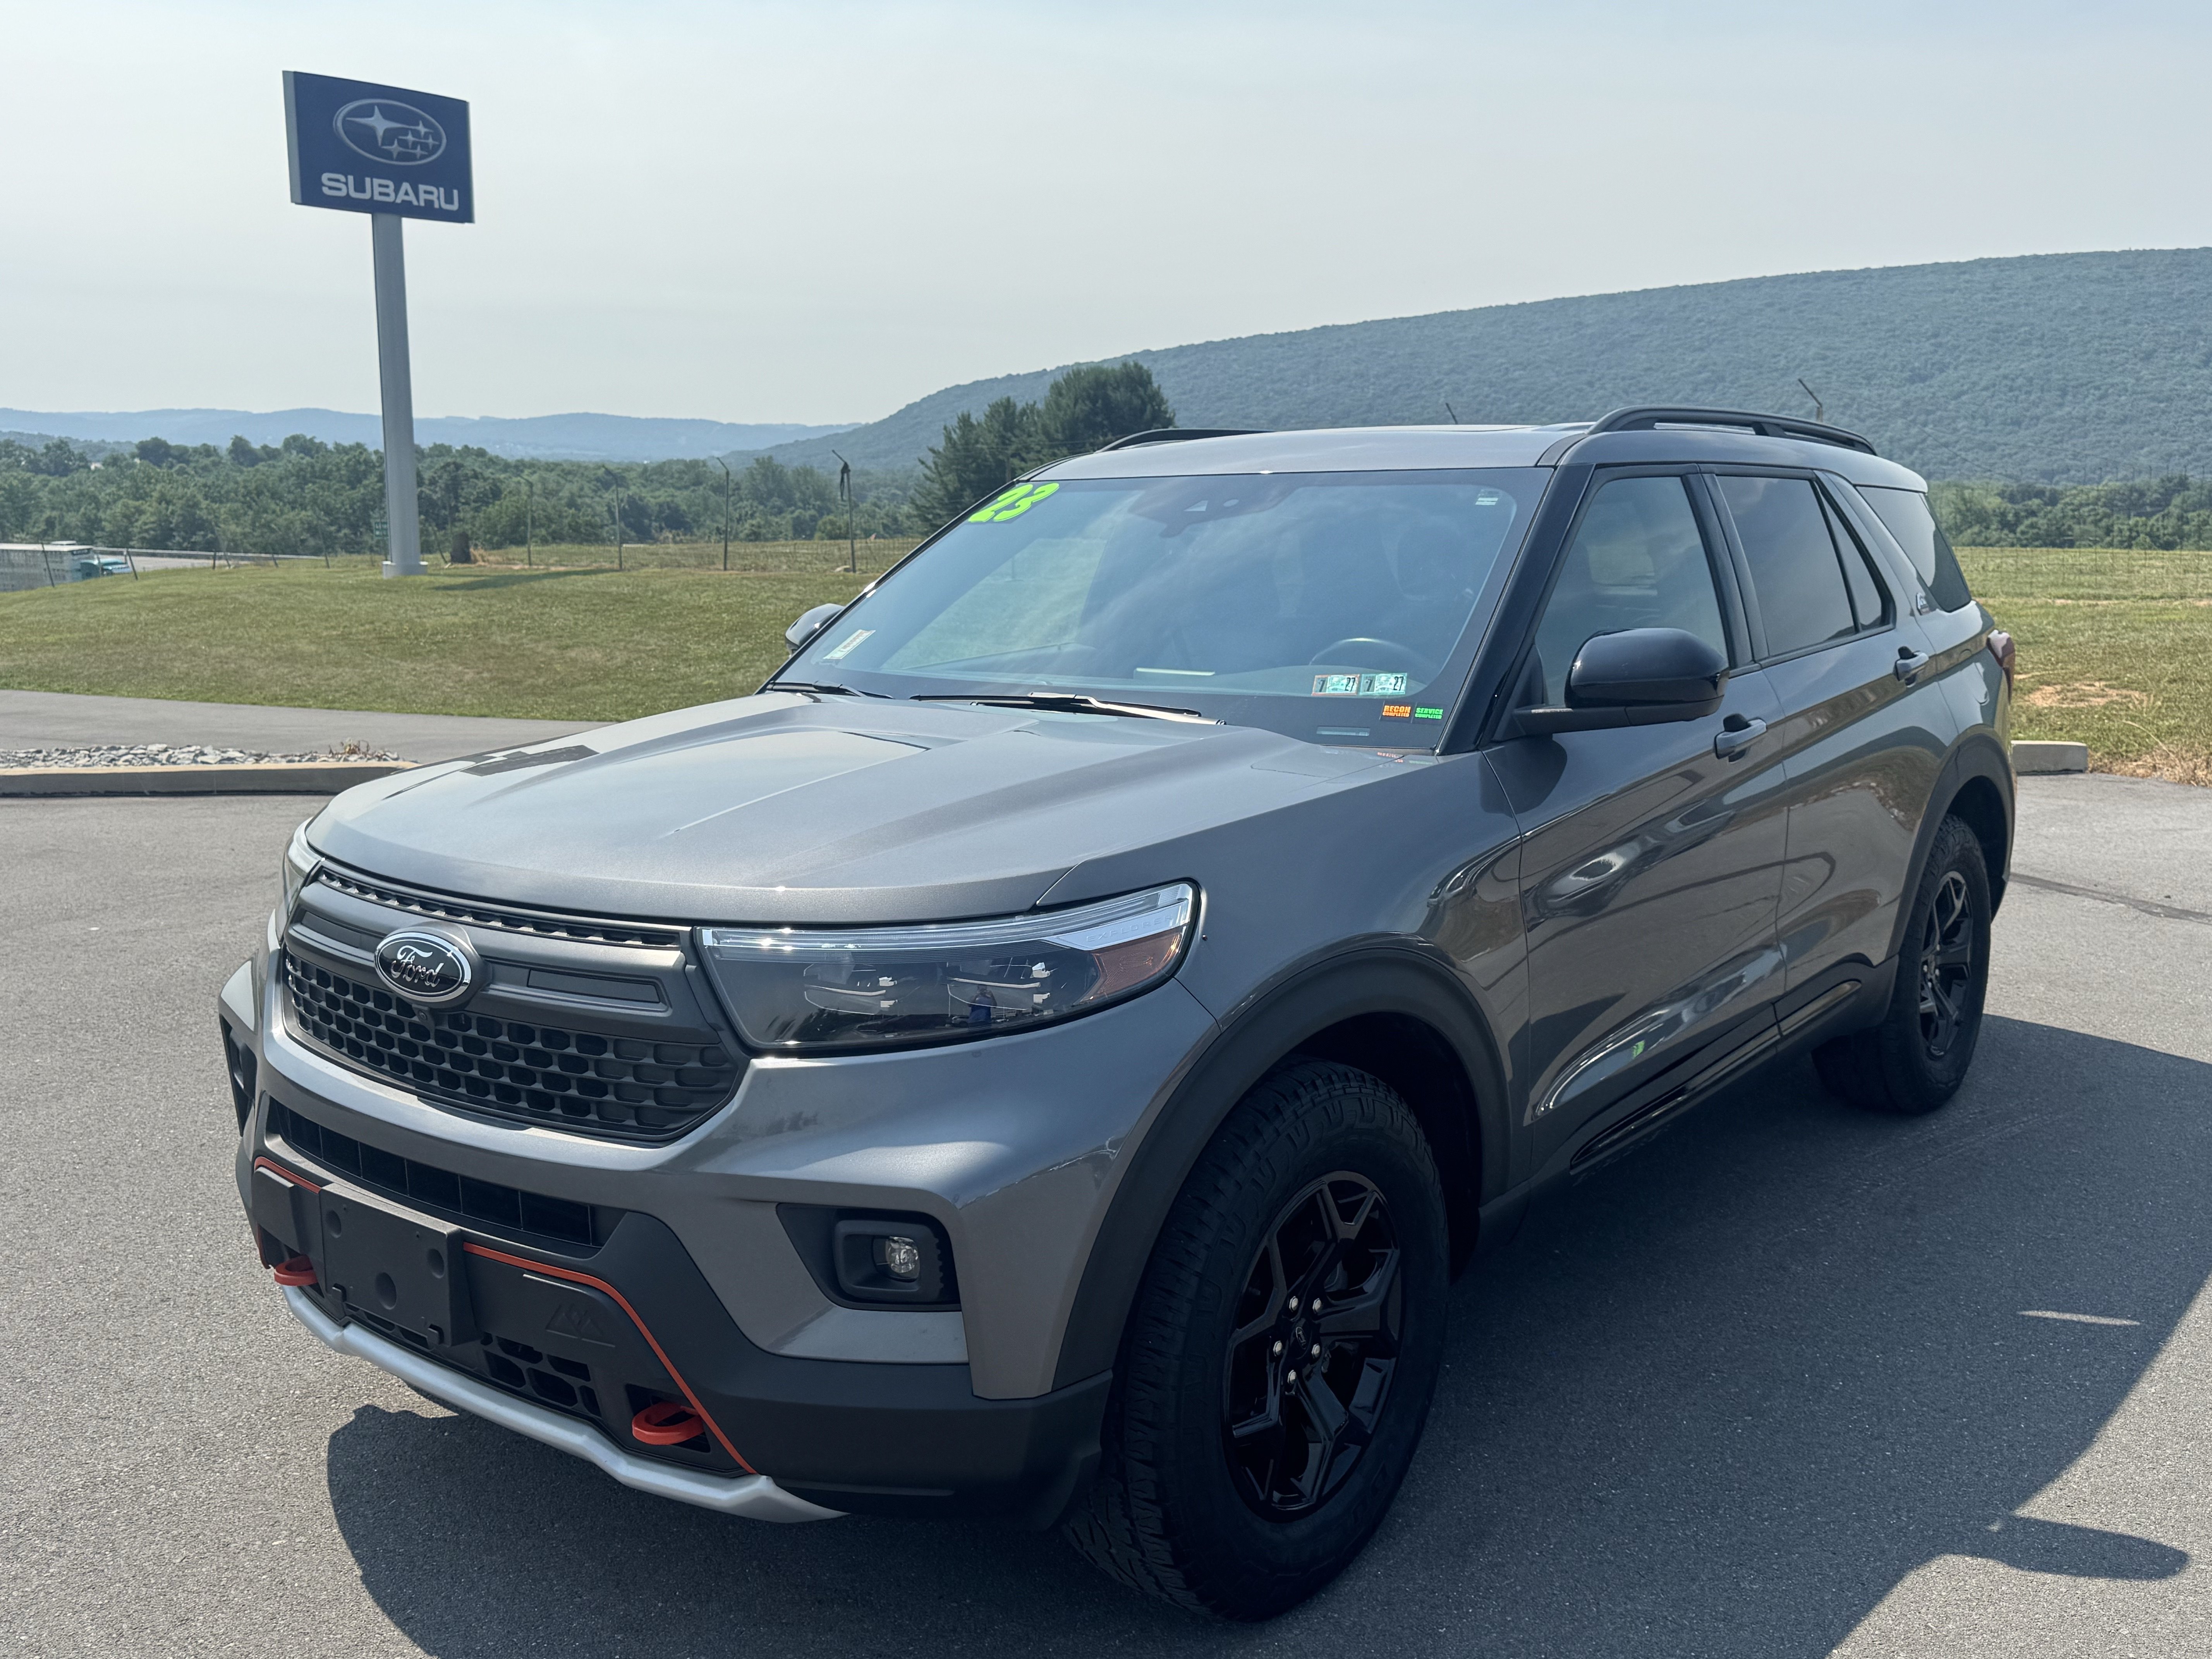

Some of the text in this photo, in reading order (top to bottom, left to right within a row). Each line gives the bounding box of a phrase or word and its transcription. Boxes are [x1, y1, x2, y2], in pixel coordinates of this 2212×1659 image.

[321, 172, 459, 211] SUBARU
[968, 483, 1060, 522] 23
[1345, 677, 1356, 692] 27
[1393, 676, 1404, 691] 27
[1383, 705, 1411, 713] RECON
[1416, 707, 1444, 715] SERVICE
[1086, 915, 1174, 942] EXPLORER
[390, 945, 444, 988] Ford
